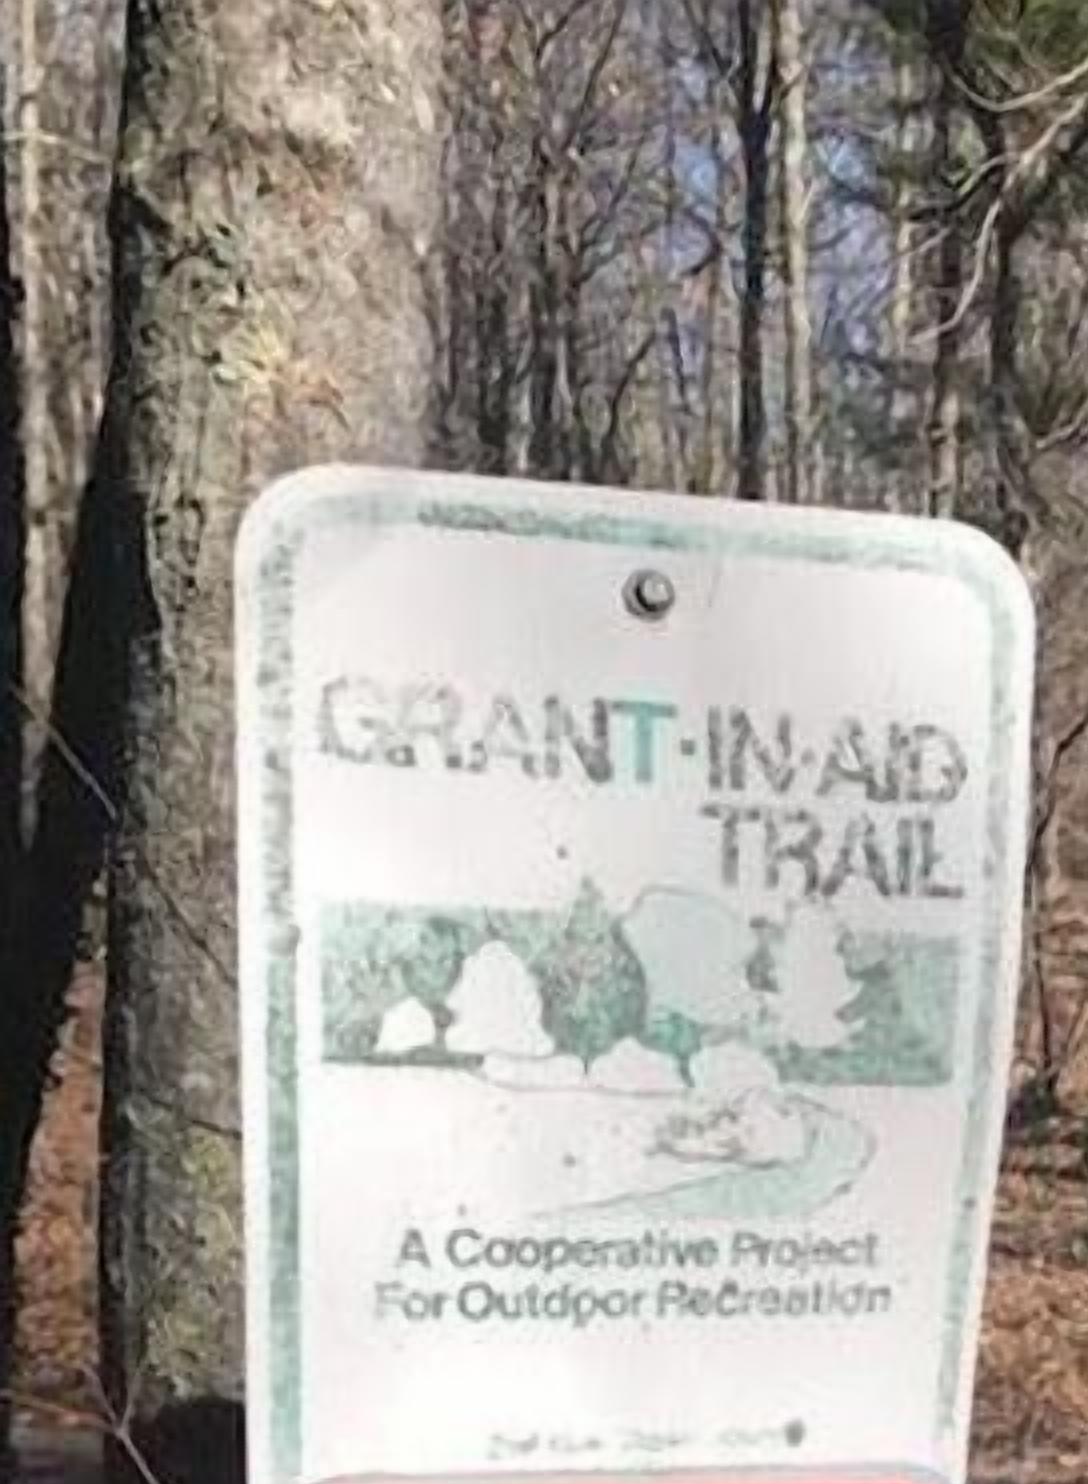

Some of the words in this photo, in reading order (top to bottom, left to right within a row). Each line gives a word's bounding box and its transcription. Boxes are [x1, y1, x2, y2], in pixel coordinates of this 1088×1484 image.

[699, 803, 966, 898] TRAIL
[397, 1228, 431, 1268] A
[444, 1227, 719, 1274] Cooperative
[730, 1230, 879, 1279] Project
[373, 1280, 449, 1321] For
[656, 1278, 892, 1320] Recreation
